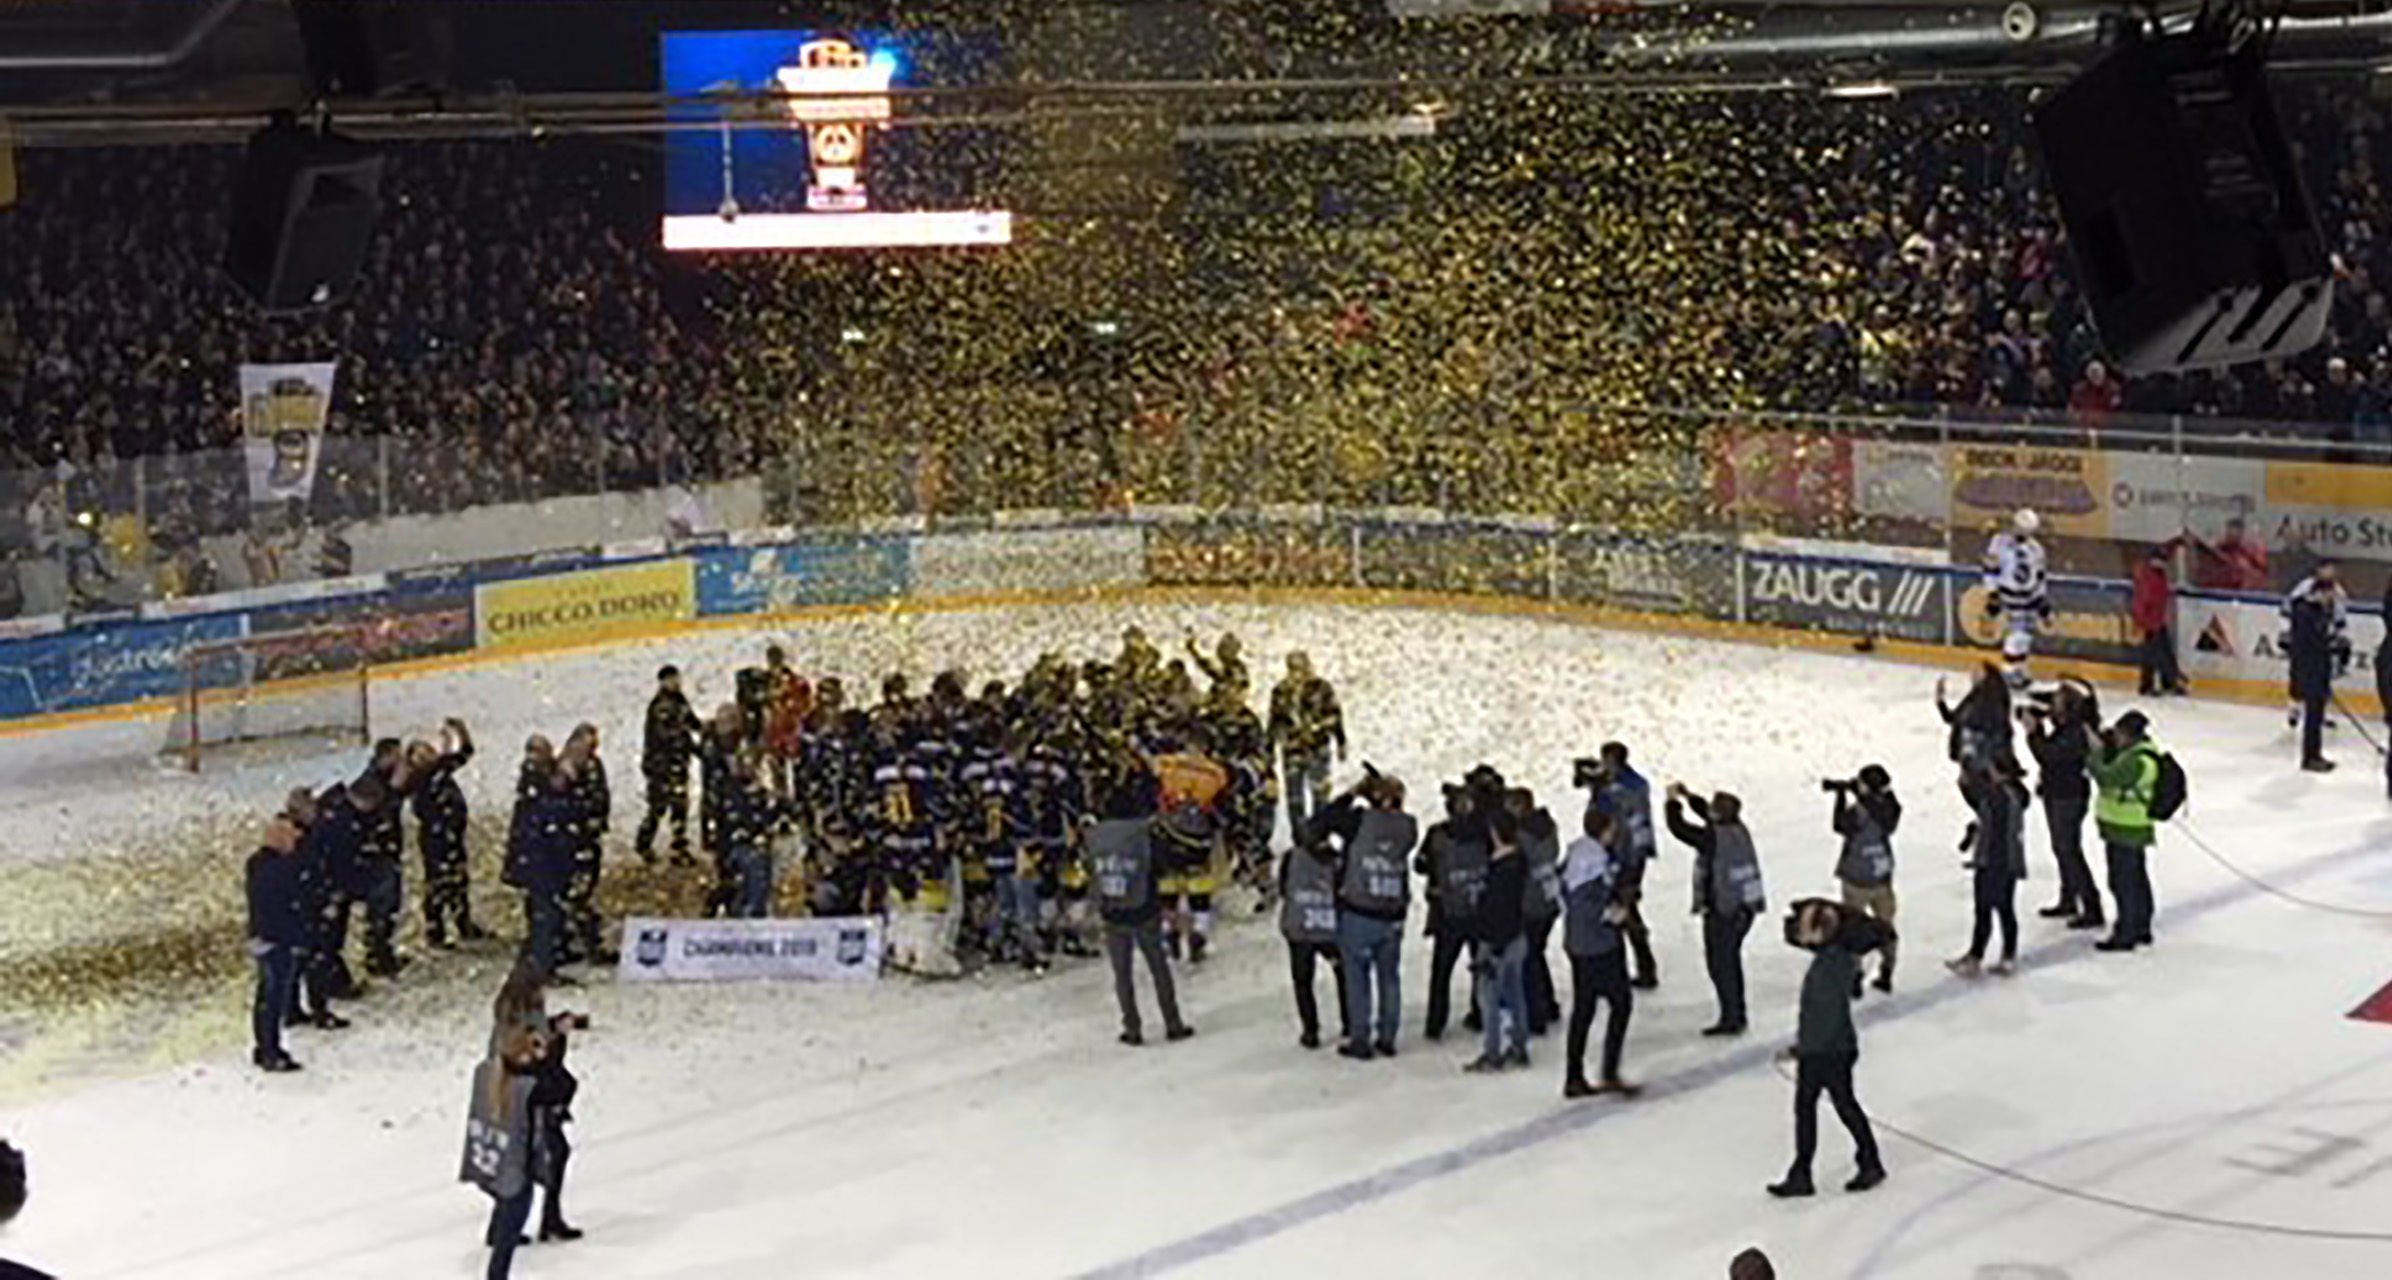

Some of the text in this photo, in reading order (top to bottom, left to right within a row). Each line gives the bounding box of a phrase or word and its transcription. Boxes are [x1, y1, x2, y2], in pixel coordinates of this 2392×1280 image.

[2276, 514, 2349, 545] Auto
[1751, 561, 1881, 613] ZAUGG
[488, 602, 594, 635] CHICCO
[682, 938, 775, 957] CHAMPIONS
